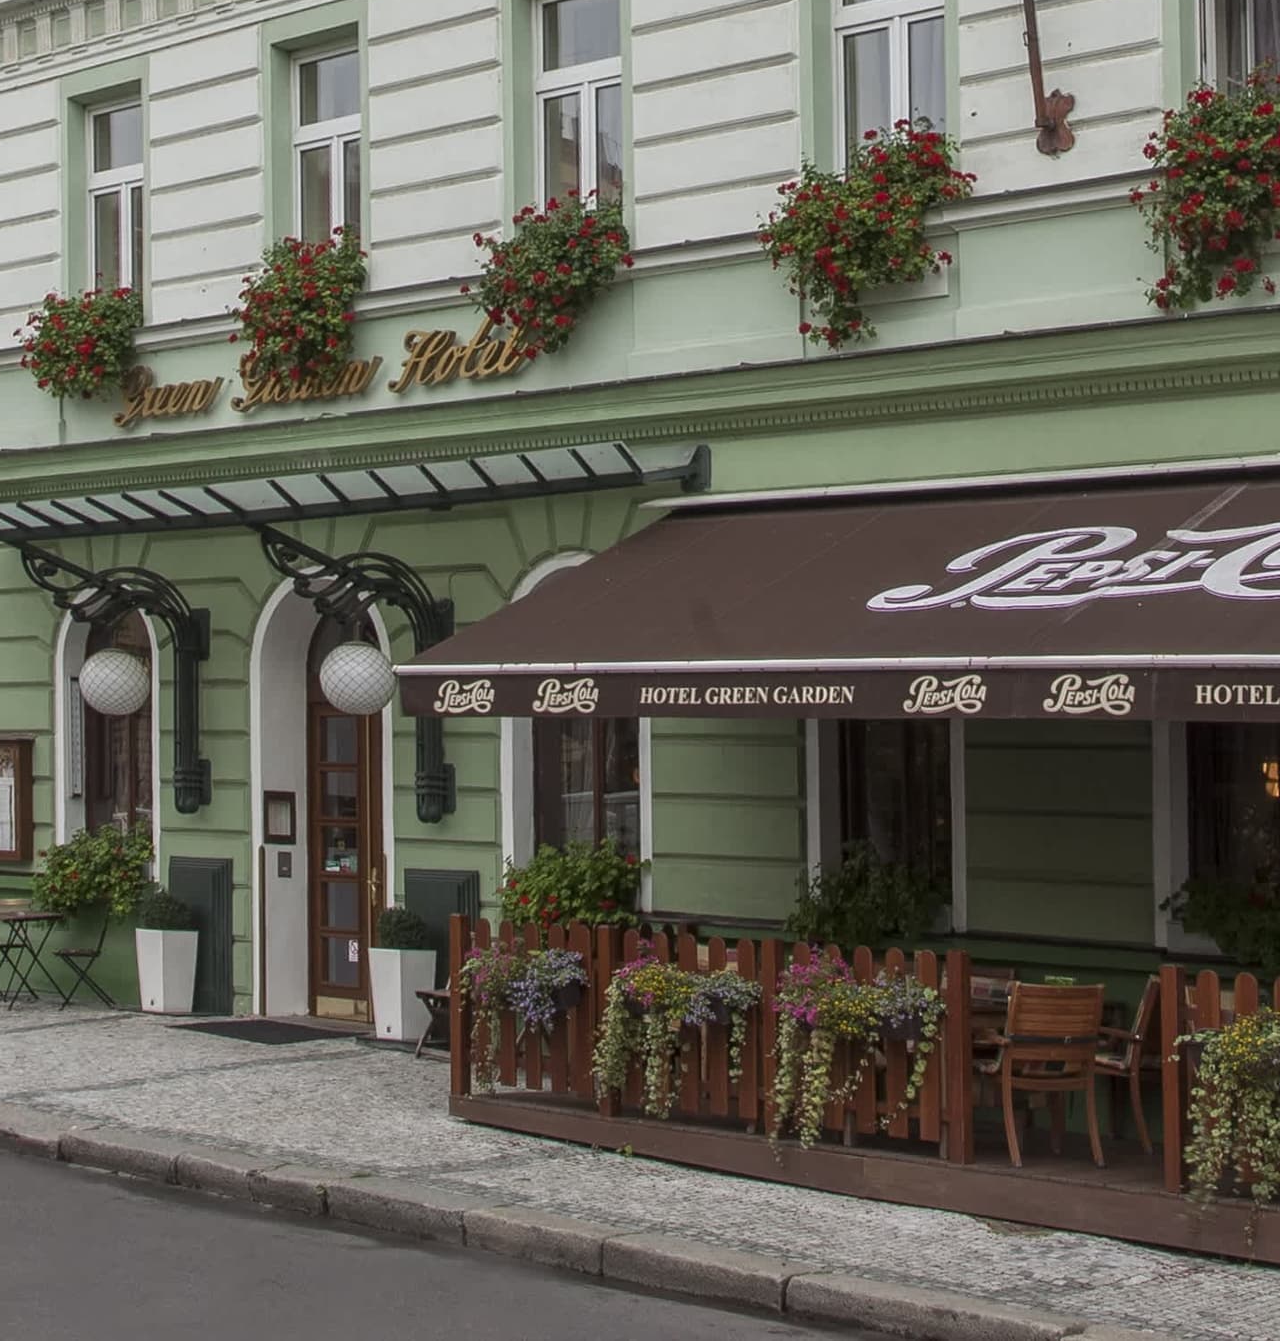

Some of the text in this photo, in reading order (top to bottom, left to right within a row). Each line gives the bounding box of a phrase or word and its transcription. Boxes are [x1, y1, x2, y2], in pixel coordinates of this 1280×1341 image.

[113, 365, 224, 427] Green
[388, 314, 528, 394] Hotel
[639, 686, 855, 704] HOTEL GREEN GARDEN
[1195, 685, 1280, 705] HOTEL
